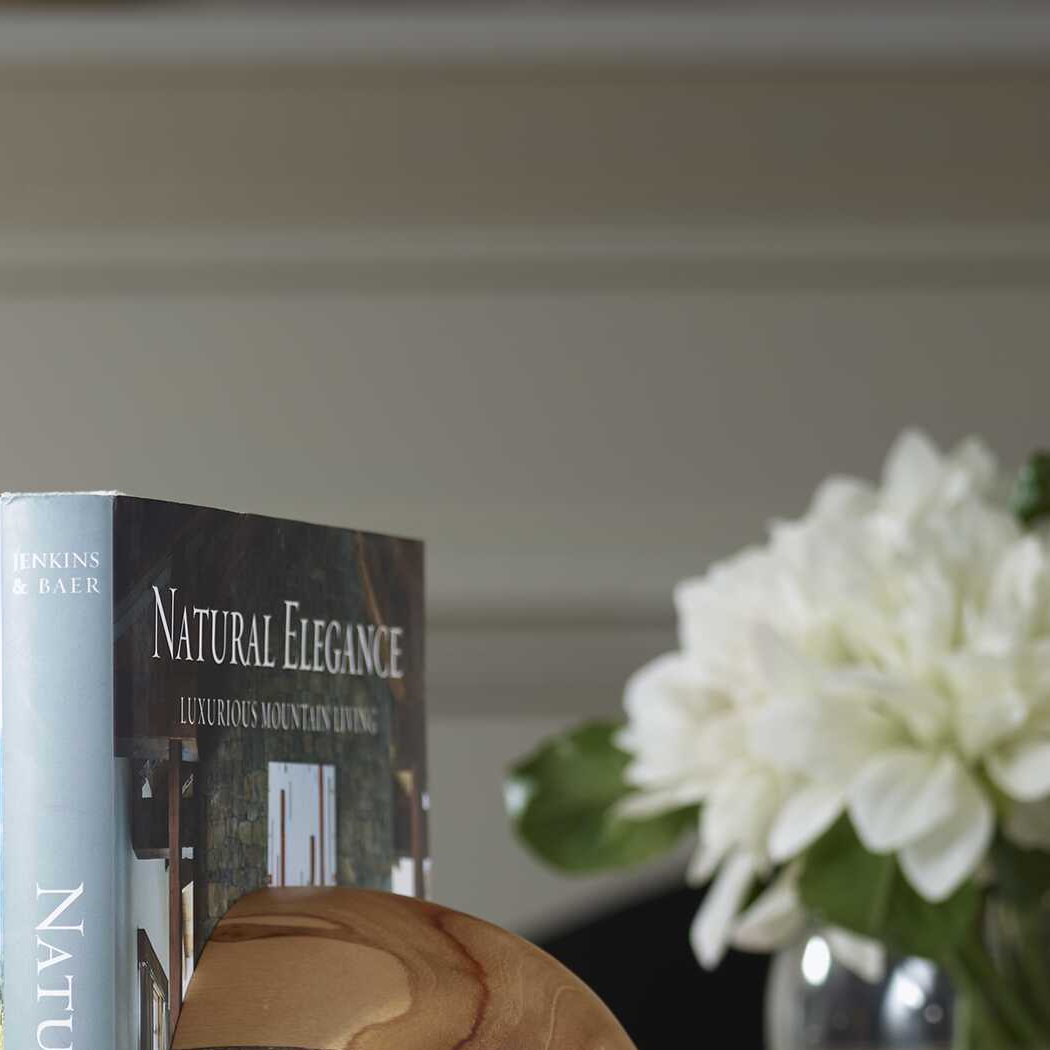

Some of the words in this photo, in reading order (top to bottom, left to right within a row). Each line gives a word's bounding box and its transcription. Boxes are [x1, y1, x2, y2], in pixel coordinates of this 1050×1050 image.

[13, 551, 100, 572] JENKINS
[12, 577, 28, 595] &
[38, 577, 101, 595] BAER
[151, 584, 276, 669] NATURAL
[283, 600, 404, 679] ELEGANCE
[180, 696, 258, 729] LUXURIOUS
[261, 701, 330, 732] MOUNTAIN
[333, 706, 378, 734] LIVING
